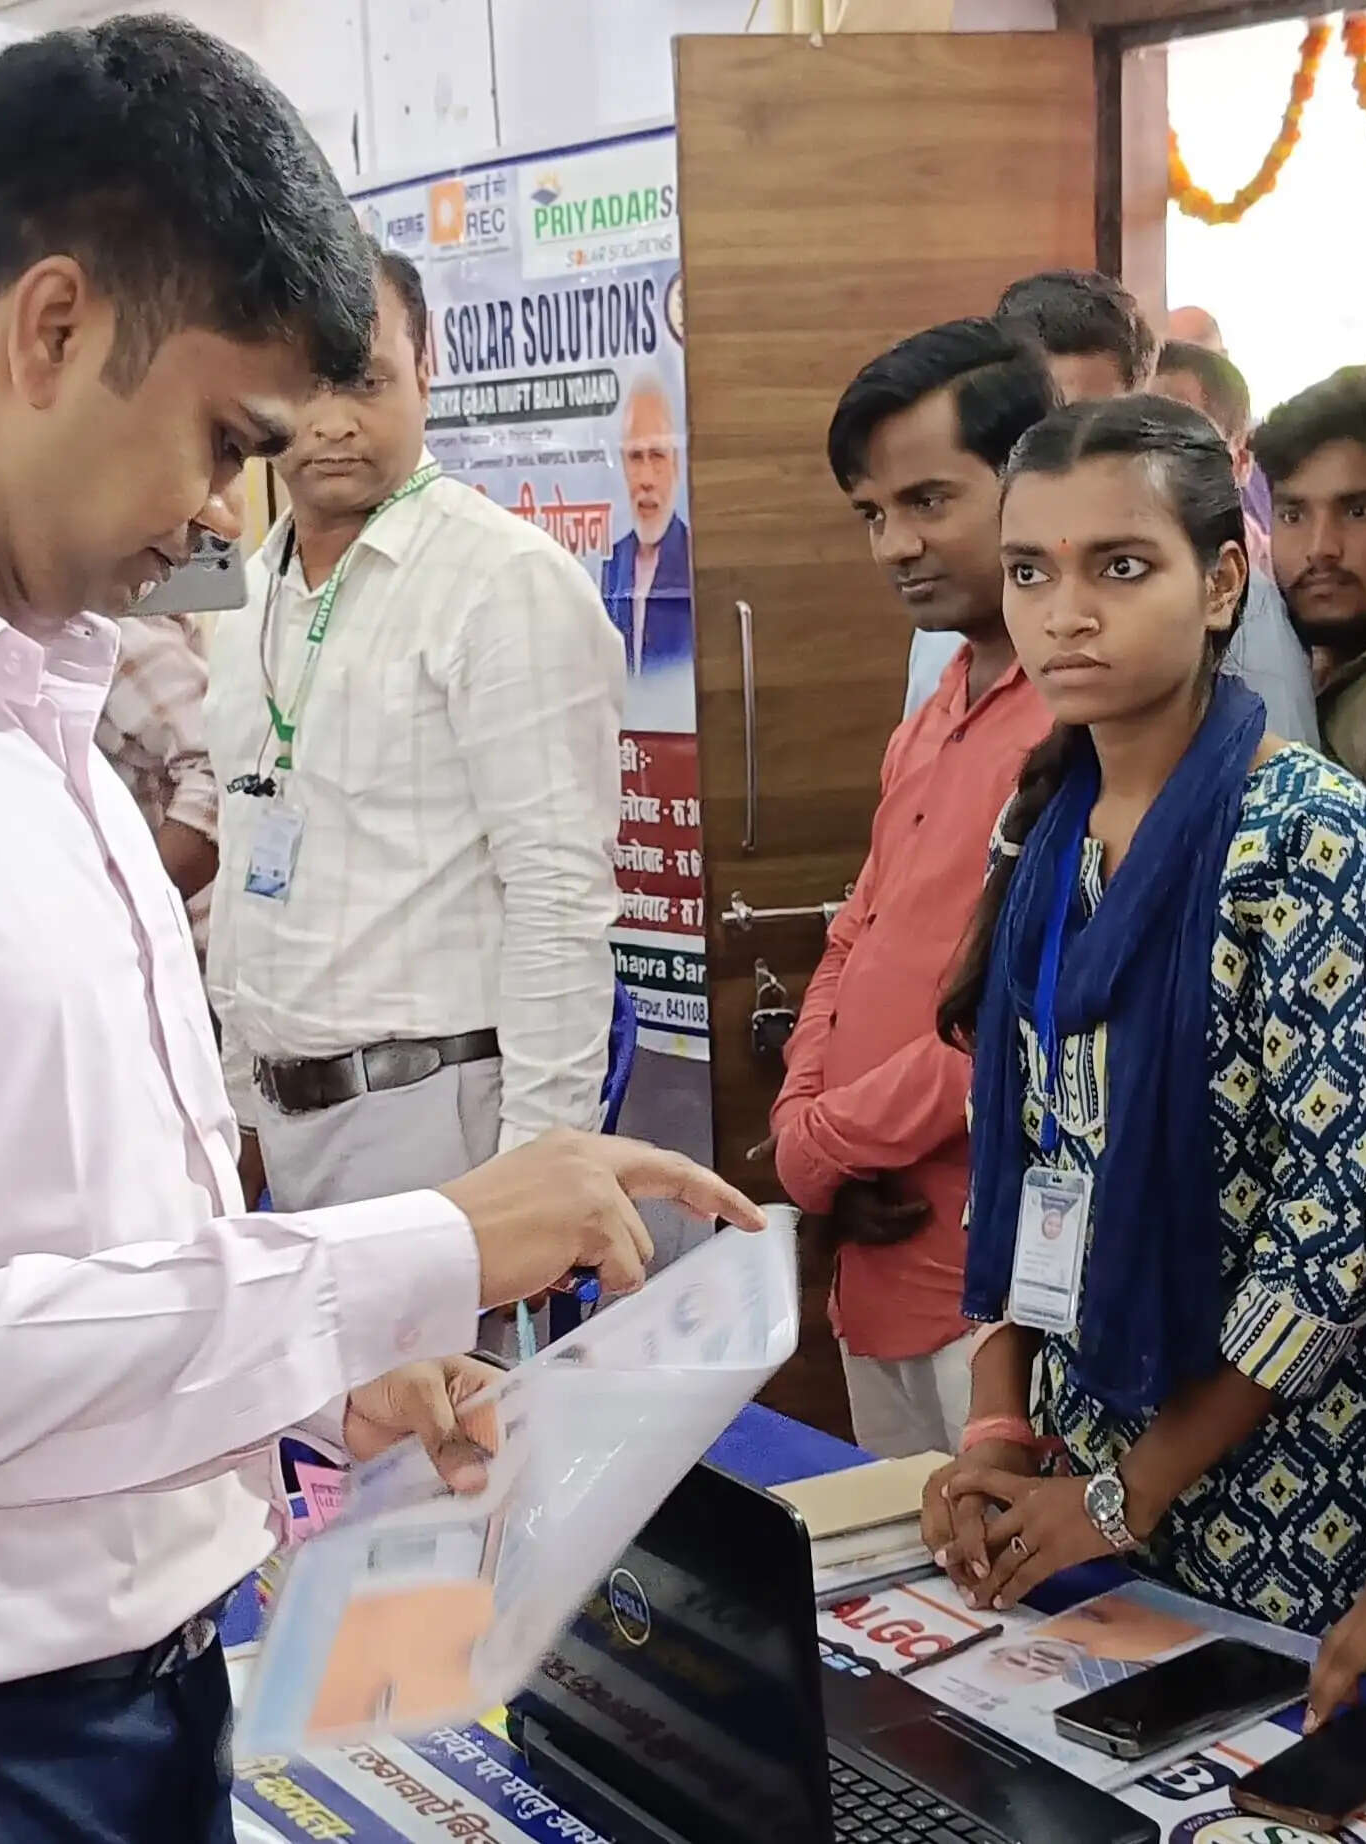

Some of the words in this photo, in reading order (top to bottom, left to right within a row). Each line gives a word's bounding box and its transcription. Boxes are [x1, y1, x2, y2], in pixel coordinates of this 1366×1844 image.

[467, 208, 506, 236] REC
[534, 184, 677, 239] PRIYADARS
[444, 300, 516, 376] SOLAR
[521, 278, 657, 367] SOLUTIONS
[690, 849, 702, 878] 6
[616, 948, 667, 981] hapra
[672, 955, 708, 984] Sar
